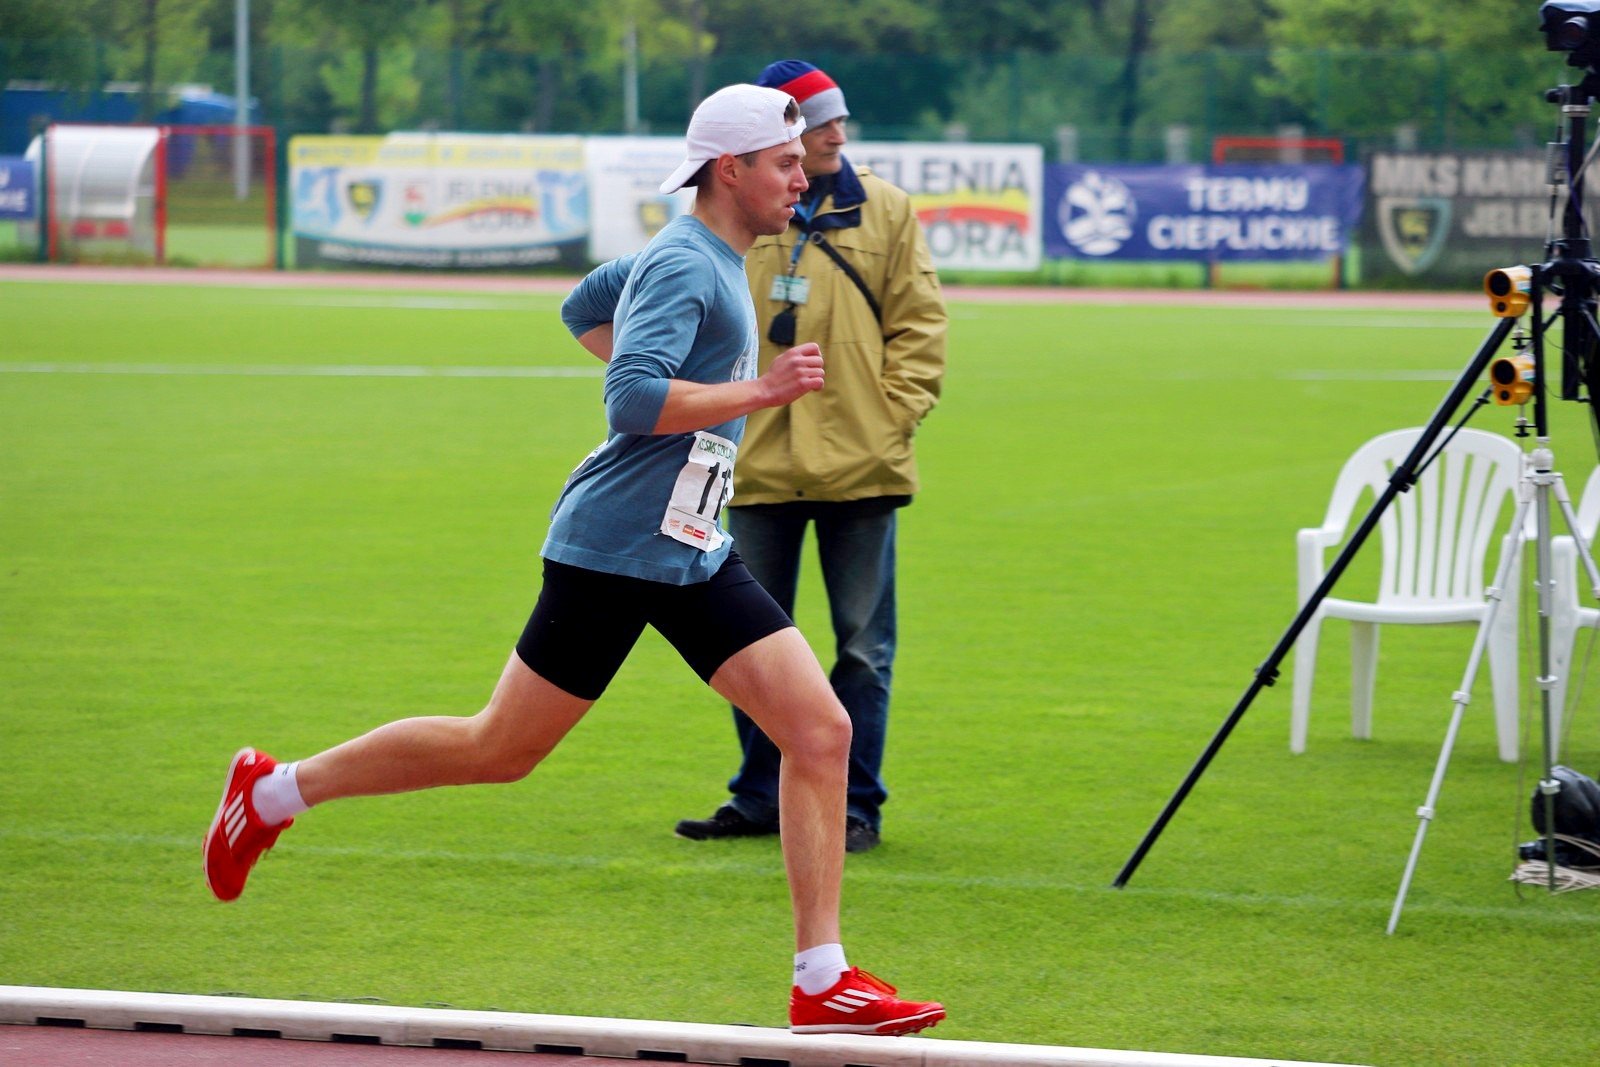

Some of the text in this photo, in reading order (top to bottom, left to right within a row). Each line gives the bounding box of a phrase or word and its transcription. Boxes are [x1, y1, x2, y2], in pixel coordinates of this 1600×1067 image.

[1372, 154, 1459, 196] MKS
[1187, 177, 1309, 212] TERMY
[1147, 215, 1340, 251] CIEPLICKIE
